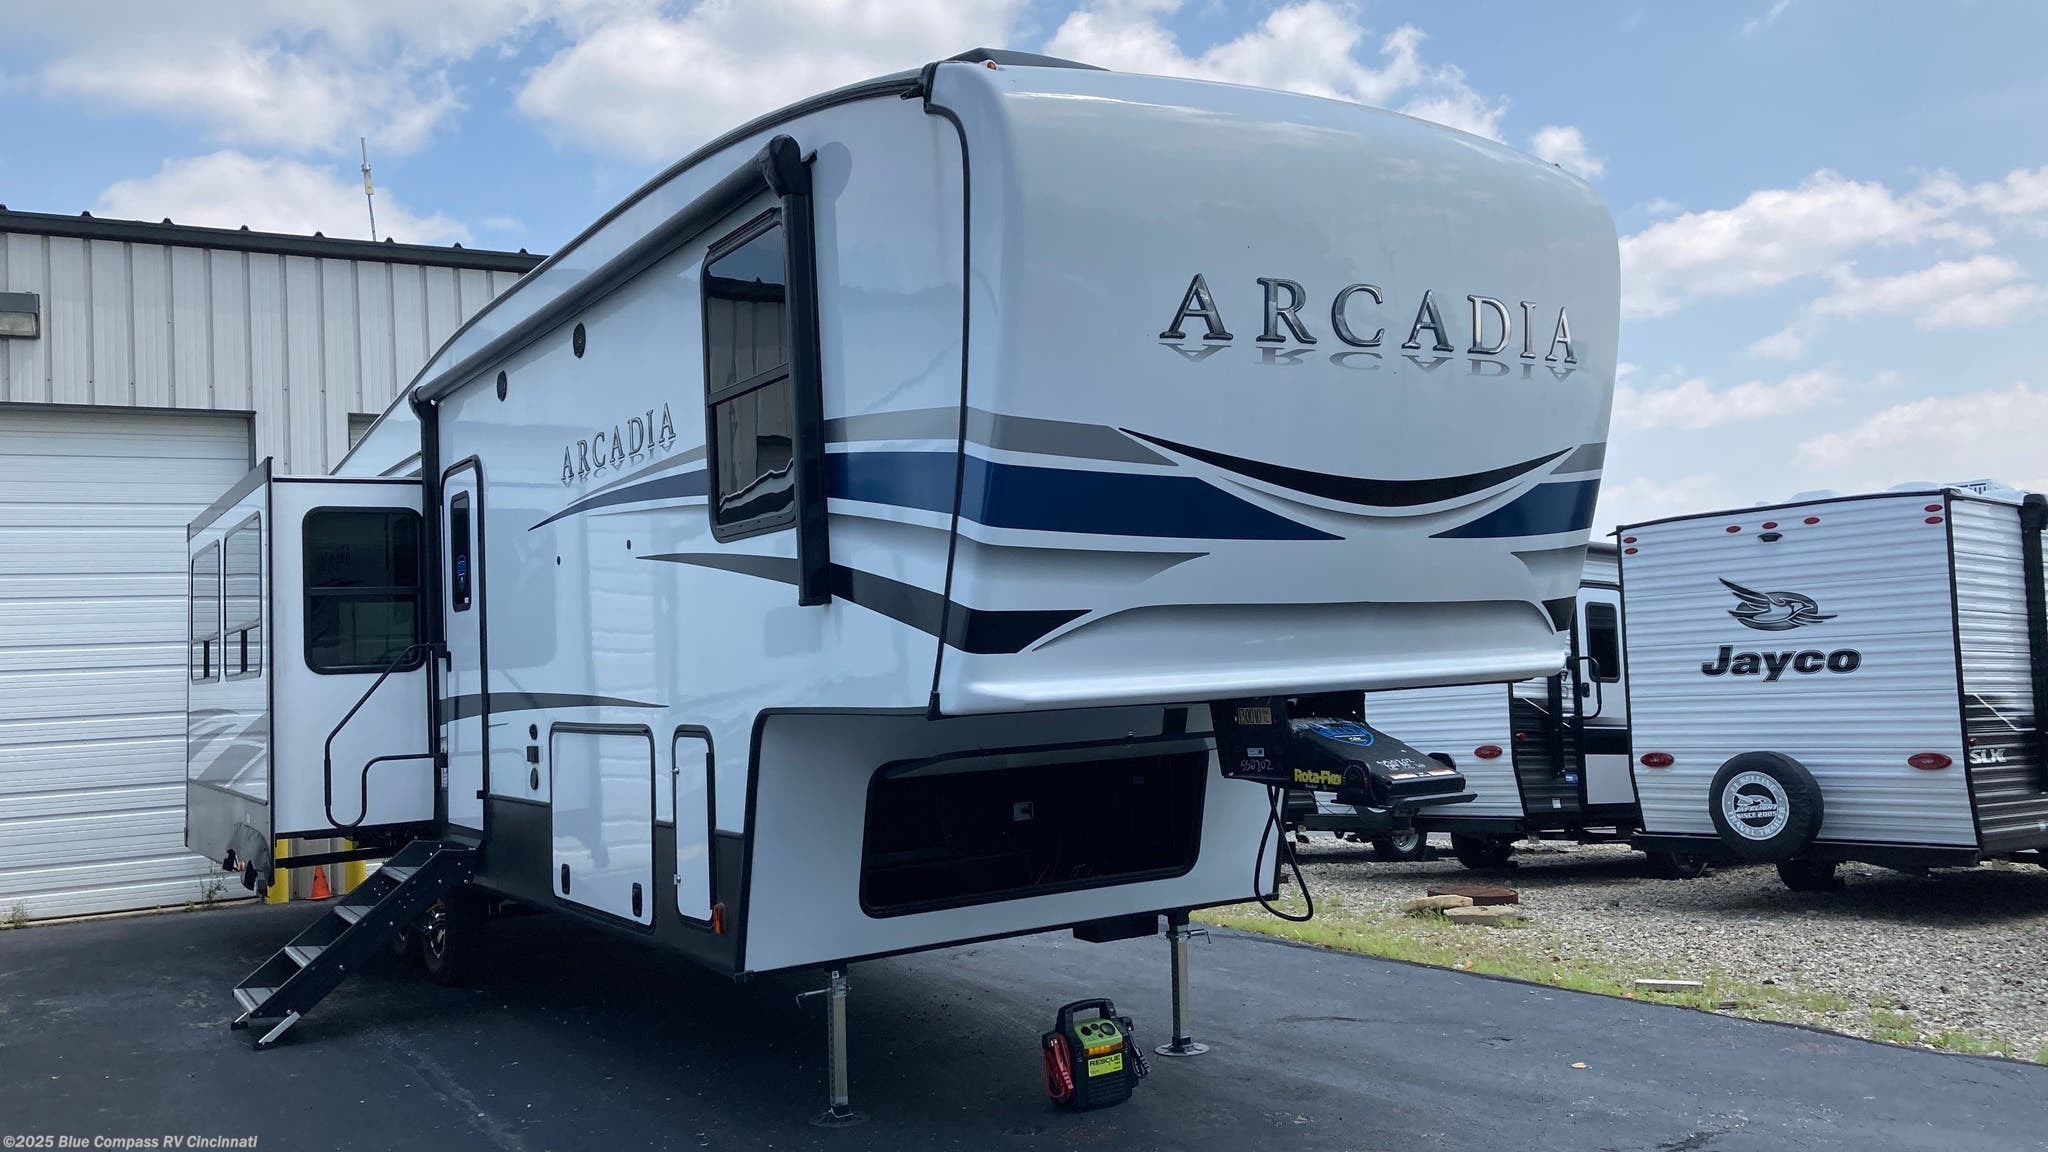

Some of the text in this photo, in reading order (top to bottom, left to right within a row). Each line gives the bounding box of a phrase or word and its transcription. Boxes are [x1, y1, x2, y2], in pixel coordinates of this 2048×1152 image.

[1159, 273, 1577, 365] ARCADIA
[561, 402, 677, 481] ARCADIA
[1701, 644, 1862, 682] Jayco
[1728, 806, 1786, 835] TRAVEL TRAILER
[1090, 1055, 1120, 1066] RESCUE
